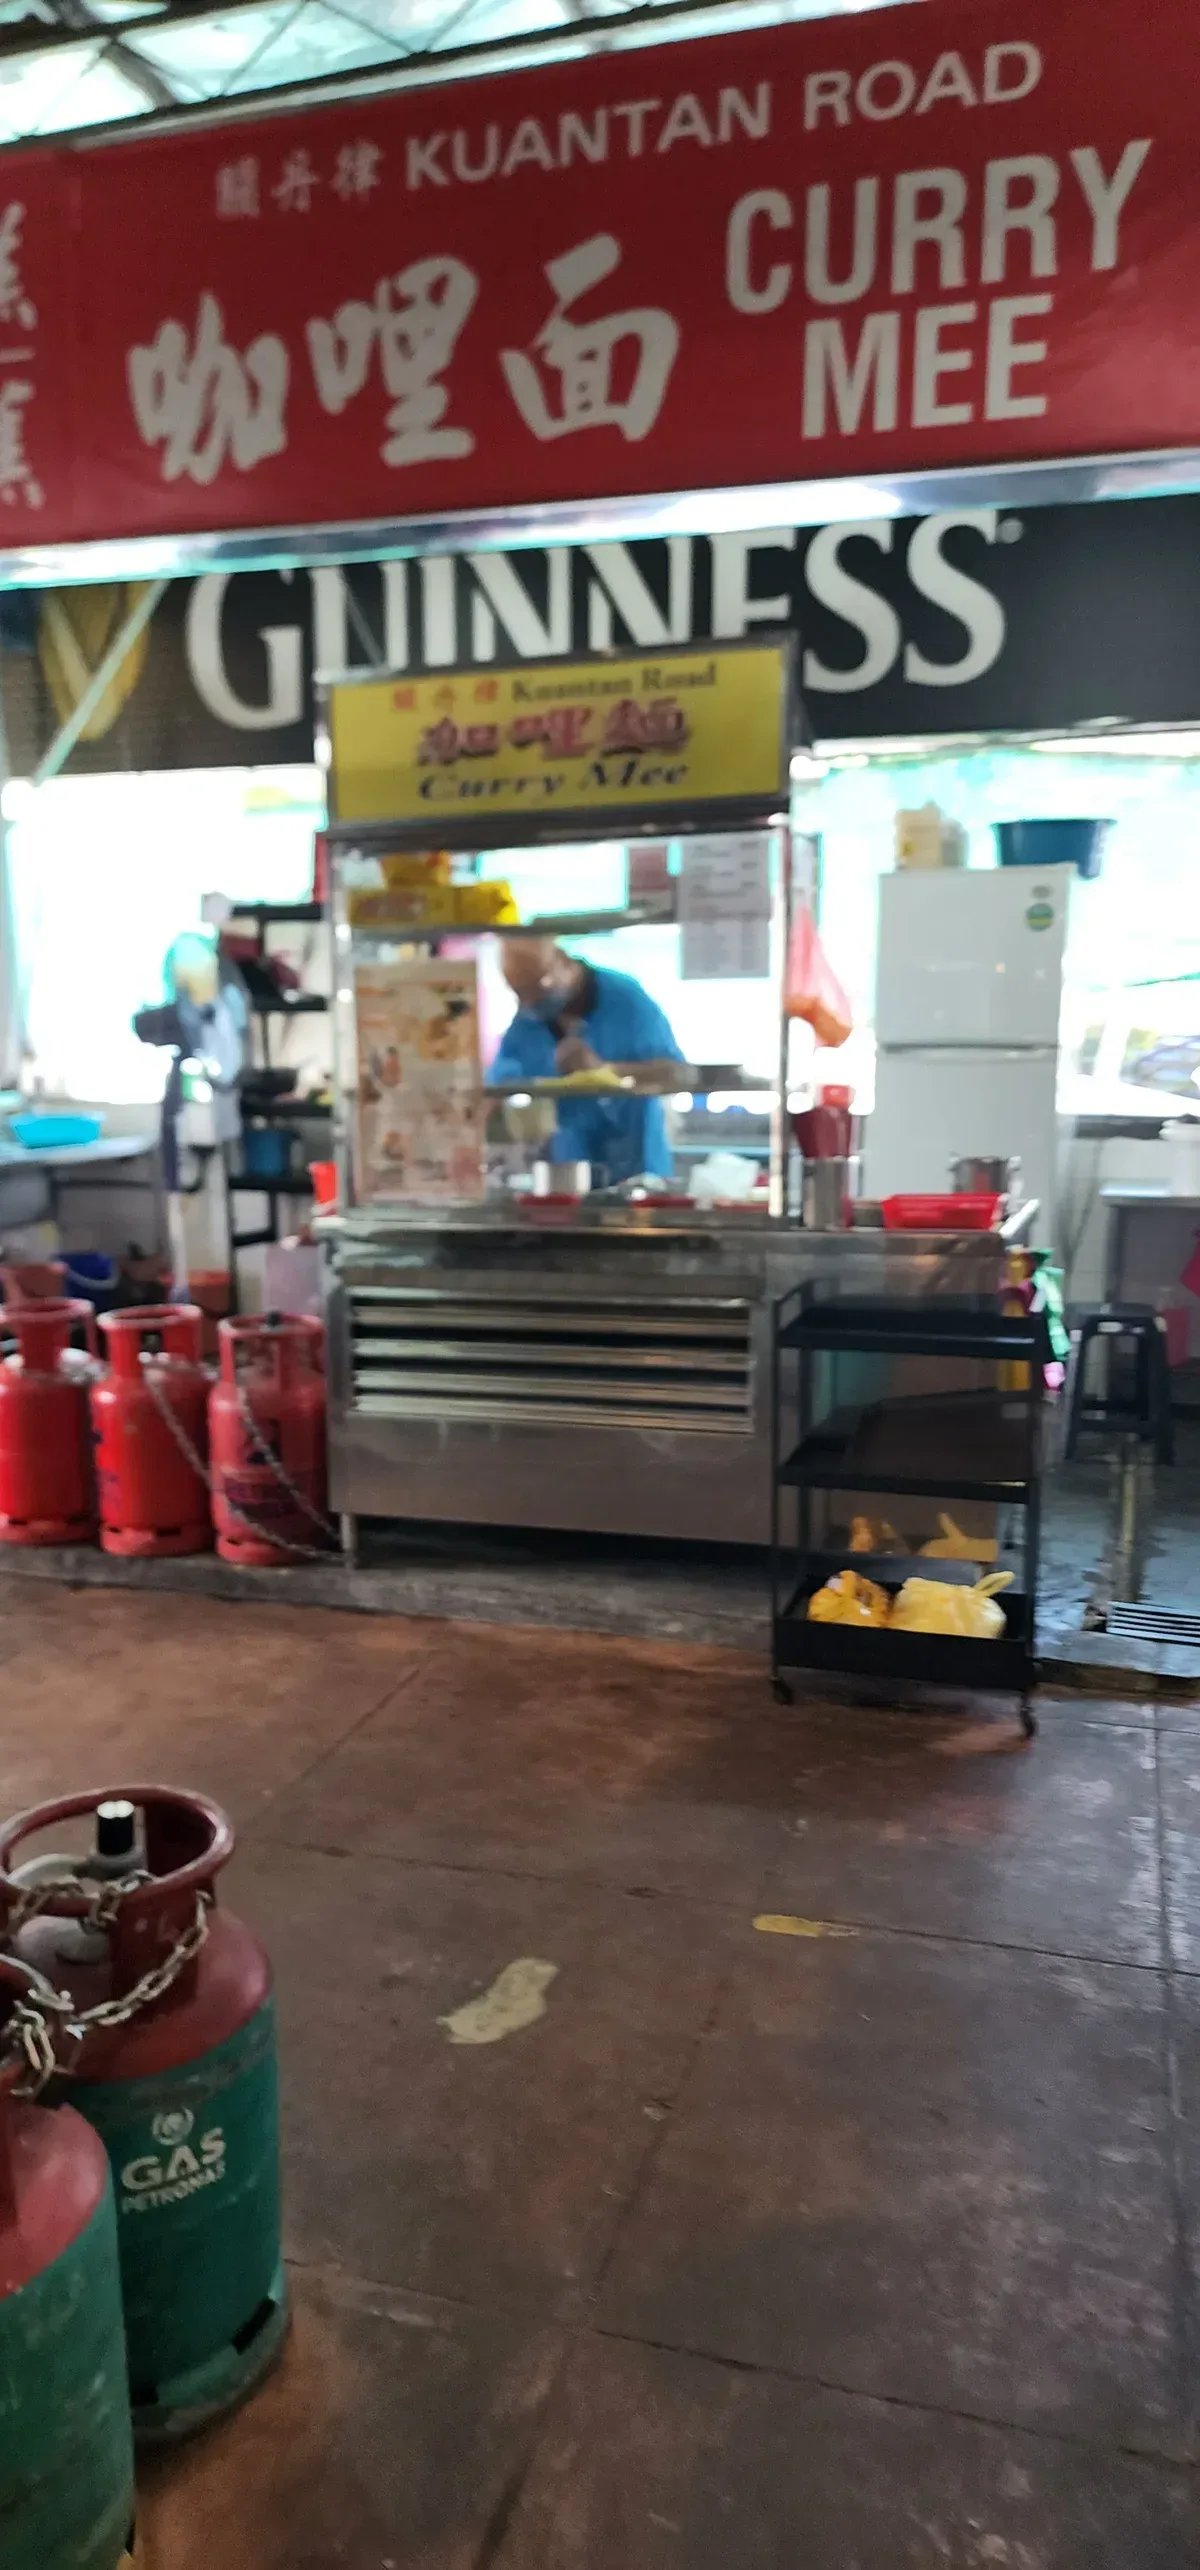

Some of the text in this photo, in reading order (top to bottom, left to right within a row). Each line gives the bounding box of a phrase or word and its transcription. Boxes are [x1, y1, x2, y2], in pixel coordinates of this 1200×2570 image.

[405, 41, 1044, 191] KUANTAN ROAD
[726, 138, 1153, 315] CURRY
[801, 293, 1054, 441] MEE
[511, 661, 717, 703] Kuantan Road
[419, 757, 690, 803] Curry Mee
[121, 2127, 226, 2190] GAS
